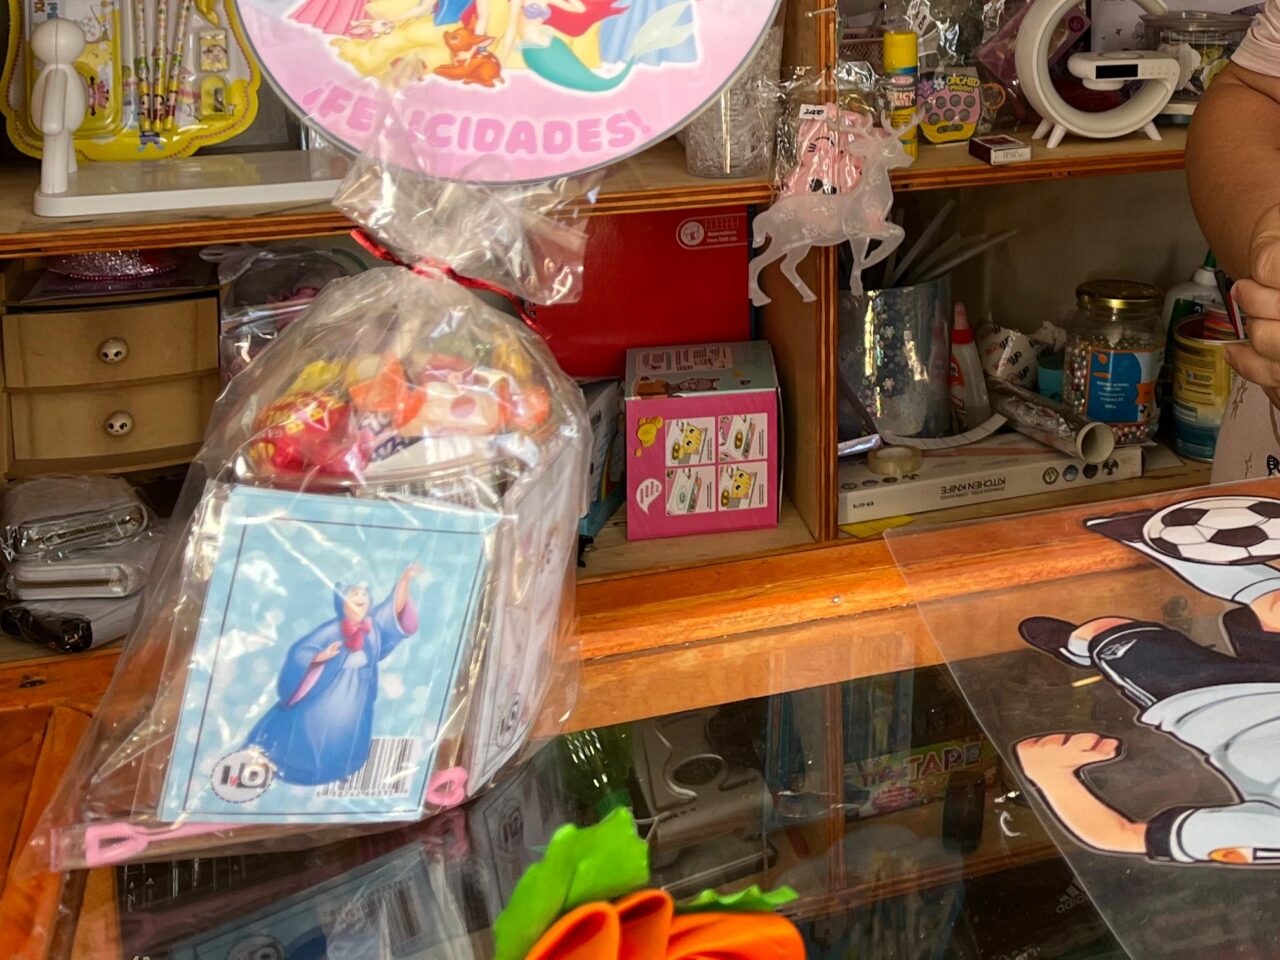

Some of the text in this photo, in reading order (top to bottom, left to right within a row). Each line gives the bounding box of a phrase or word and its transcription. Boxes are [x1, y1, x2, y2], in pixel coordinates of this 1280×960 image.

[946, 76, 980, 87] ORCHID
[940, 484, 967, 495] KNIFE
[967, 477, 1006, 491] KITCHEN
[903, 742, 982, 780] TAPE
